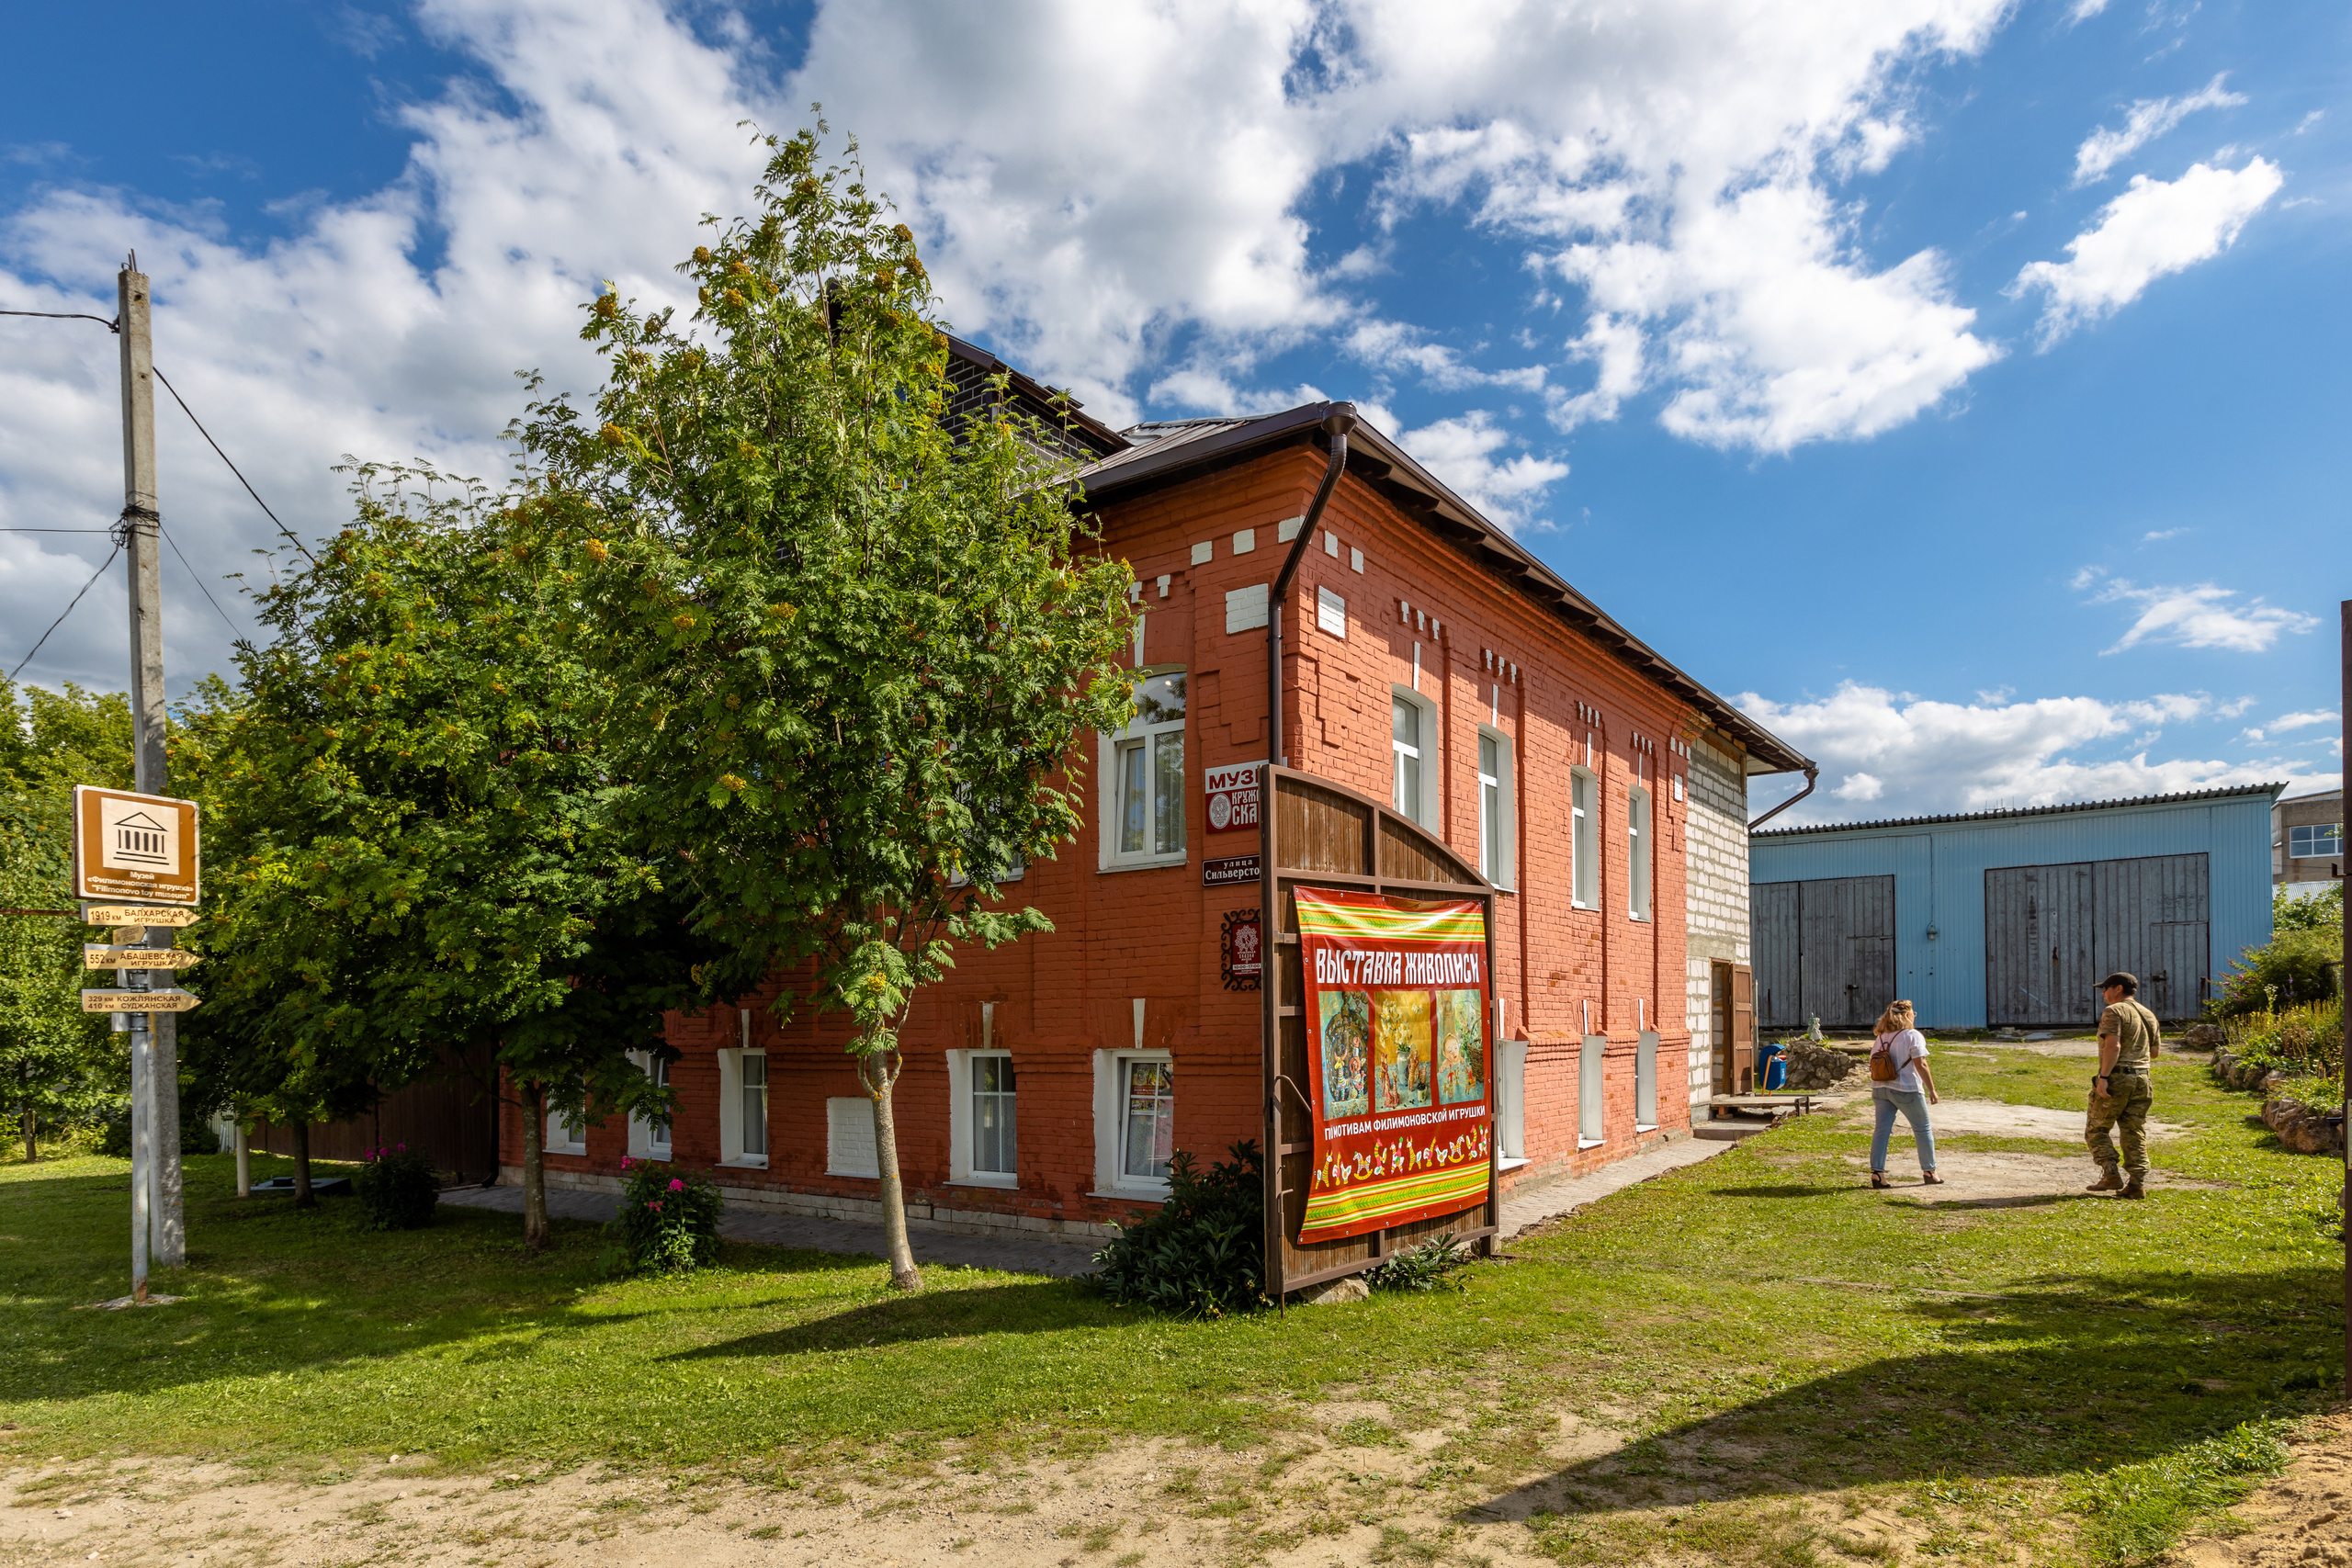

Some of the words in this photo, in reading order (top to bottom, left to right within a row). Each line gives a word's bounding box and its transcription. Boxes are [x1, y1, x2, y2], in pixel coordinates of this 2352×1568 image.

[1209, 769, 1259, 790] МУЗ
[1232, 803, 1258, 825] СКА
[1224, 859, 1252, 869] улица
[130, 871, 155, 880] Музей
[1205, 867, 1260, 880] Сильверсто
[141, 888, 153, 897] toy
[90, 910, 110, 920] 1919
[124, 909, 184, 918] БАЛХАРСКАЯ
[89, 953, 106, 964] 552
[1316, 948, 1402, 985] ВЫСТАВКА
[1405, 952, 1480, 985] ЖИВОПИСИ
[1373, 1108, 1448, 1132] ФИЛИМОНОВСКОЙ
[1448, 1104, 1486, 1121] ИГРУШКИ
